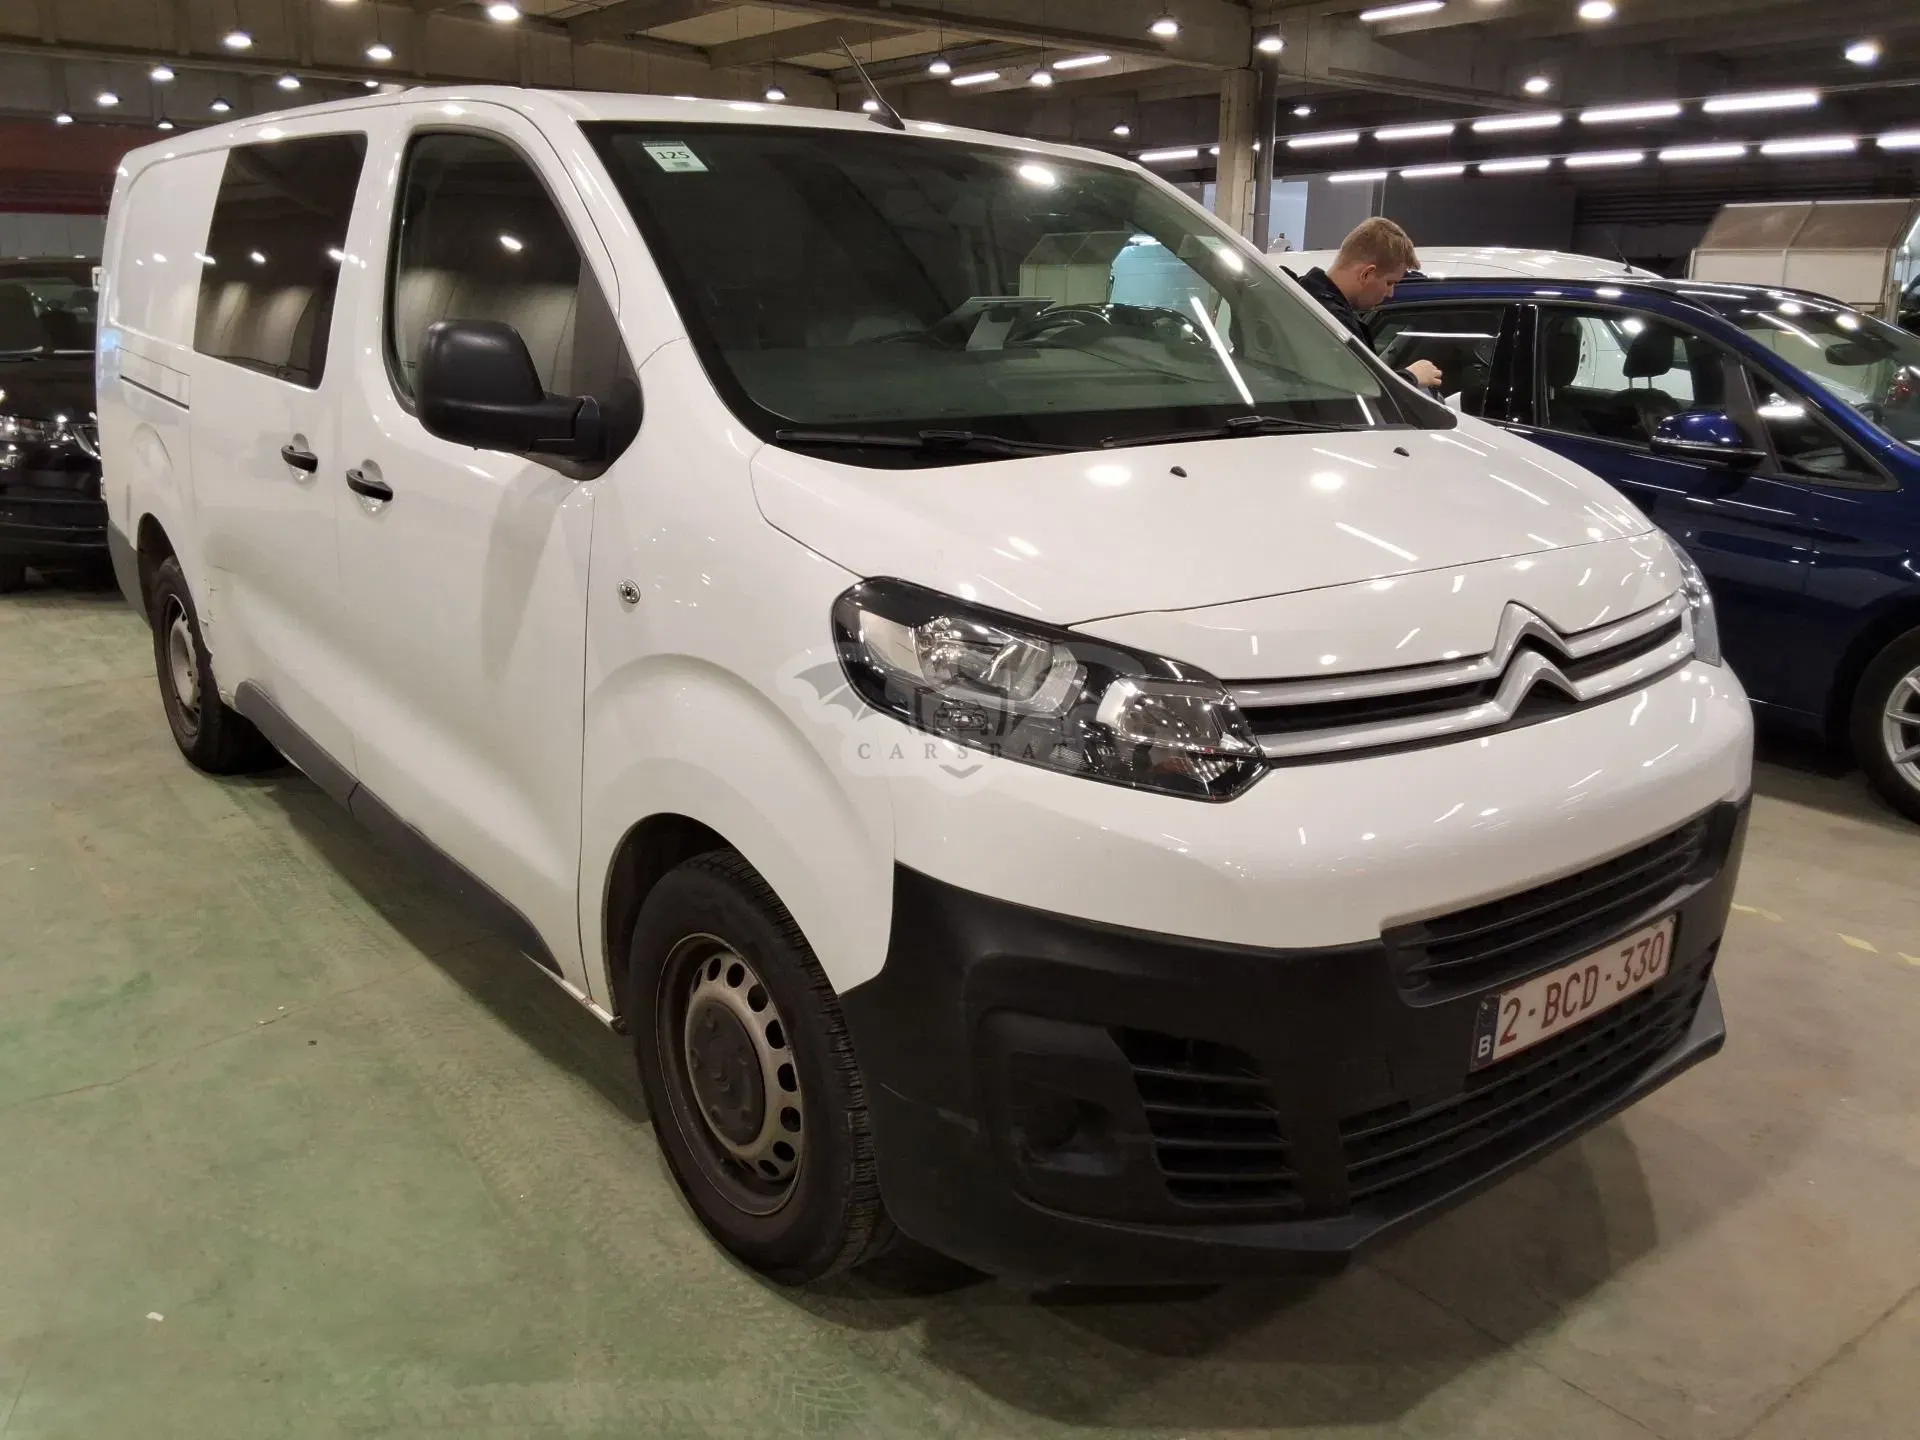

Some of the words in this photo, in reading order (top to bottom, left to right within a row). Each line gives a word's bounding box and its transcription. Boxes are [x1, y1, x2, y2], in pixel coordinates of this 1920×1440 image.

[656, 151, 690, 159] 125
[1499, 931, 1665, 1046] 2-BCD-330
[1477, 1034, 1492, 1058] B
